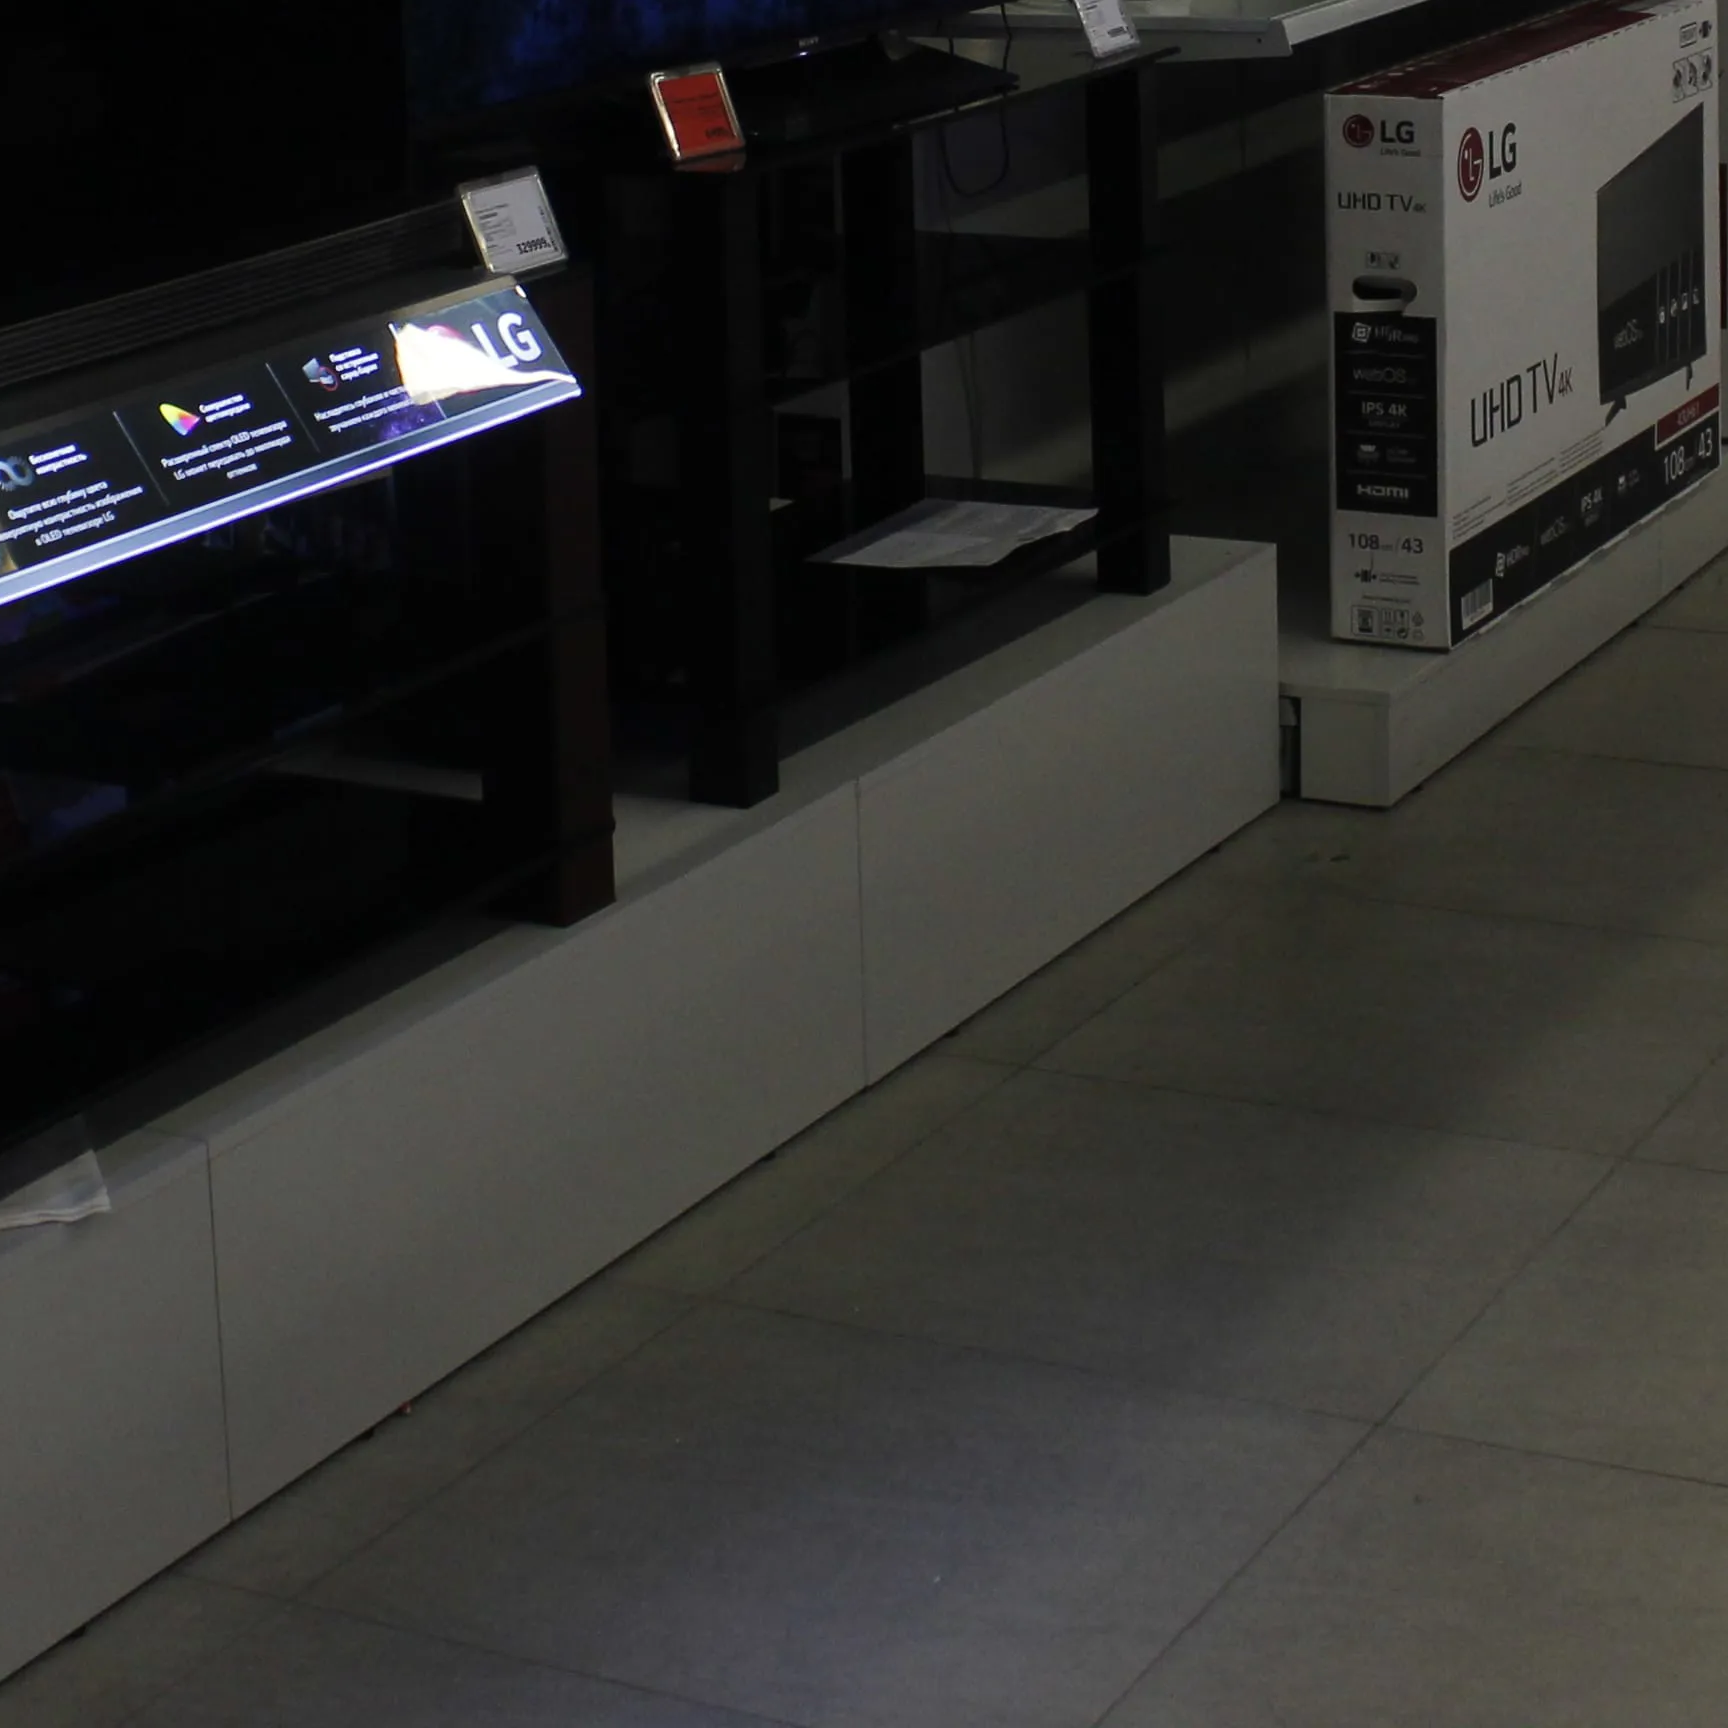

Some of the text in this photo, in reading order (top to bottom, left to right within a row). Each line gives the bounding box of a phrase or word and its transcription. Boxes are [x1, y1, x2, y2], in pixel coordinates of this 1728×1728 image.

[1380, 120, 1414, 144] LG
[1488, 122, 1517, 180] LG
[1337, 192, 1381, 211] UHD
[1385, 194, 1413, 213] TV
[471, 312, 542, 370] LG
[1361, 401, 1408, 418] IPS 4K
[1471, 353, 1573, 448] UHD TV 4K
[1664, 428, 1713, 486] 108 43
[40, 530, 63, 545] OLED
[103, 511, 115, 523] LG
[1349, 533, 1424, 554] 108 43
